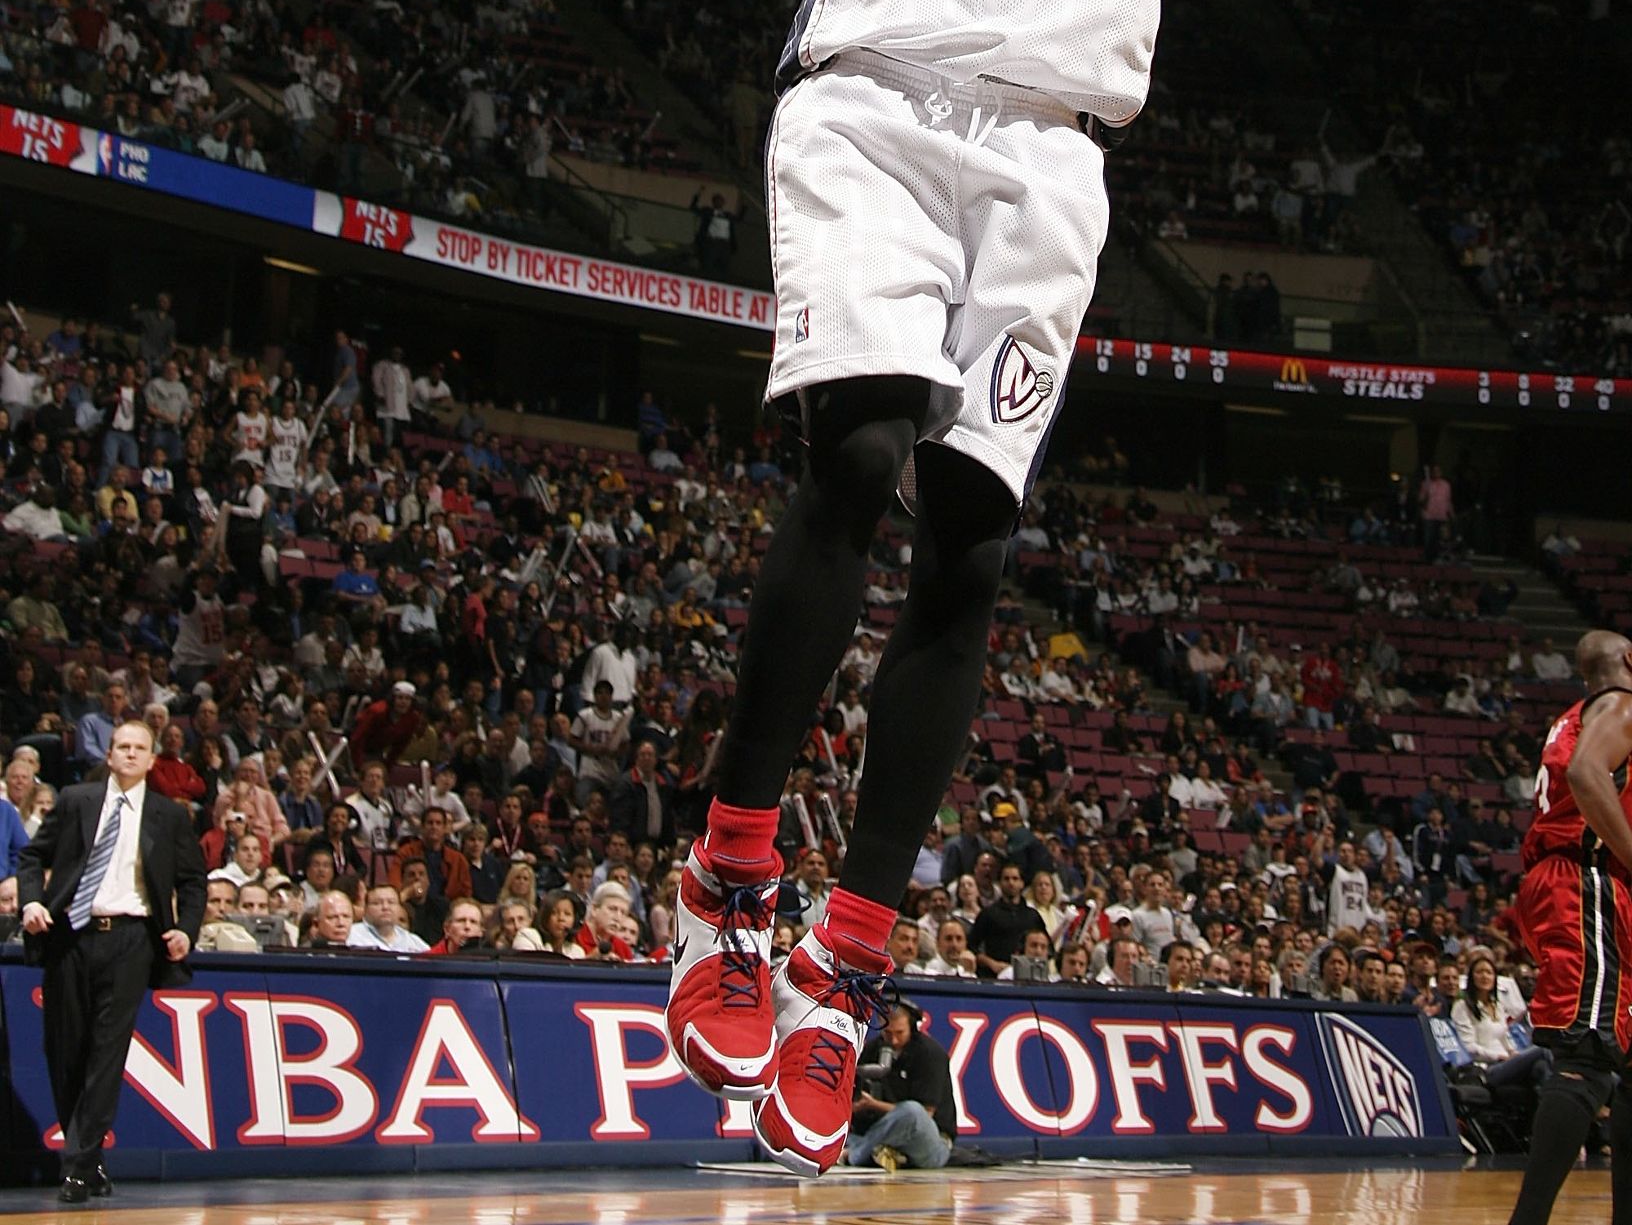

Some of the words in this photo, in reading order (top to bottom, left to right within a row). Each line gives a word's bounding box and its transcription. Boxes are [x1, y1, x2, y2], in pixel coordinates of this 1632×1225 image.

[12, 108, 64, 150] NETS
[355, 200, 398, 237] NETS
[436, 226, 483, 265] STOP
[488, 240, 514, 270] BY
[516, 248, 581, 288] TICKET
[587, 262, 681, 308] SERVICES
[687, 280, 743, 319] TABLE
[748, 295, 770, 324] AT
[1096, 339, 1114, 356] 12
[1134, 342, 1152, 360] 15
[1171, 346, 1191, 363] 24
[1097, 356, 1110, 373] 0
[1135, 360, 1149, 376] 0
[1174, 363, 1187, 380] 0
[1212, 367, 1225, 384] 0
[1328, 364, 1386, 382] HUSTLE
[1389, 367, 1436, 384] STATS
[1343, 380, 1424, 400] STEALS
[1478, 388, 1491, 404] 0
[1518, 390, 1531, 406] 0
[1557, 392, 1571, 408] 0
[1597, 394, 1610, 410] 0
[34, 989, 541, 1150] NBA
[1332, 1022, 1422, 1137] NETS
